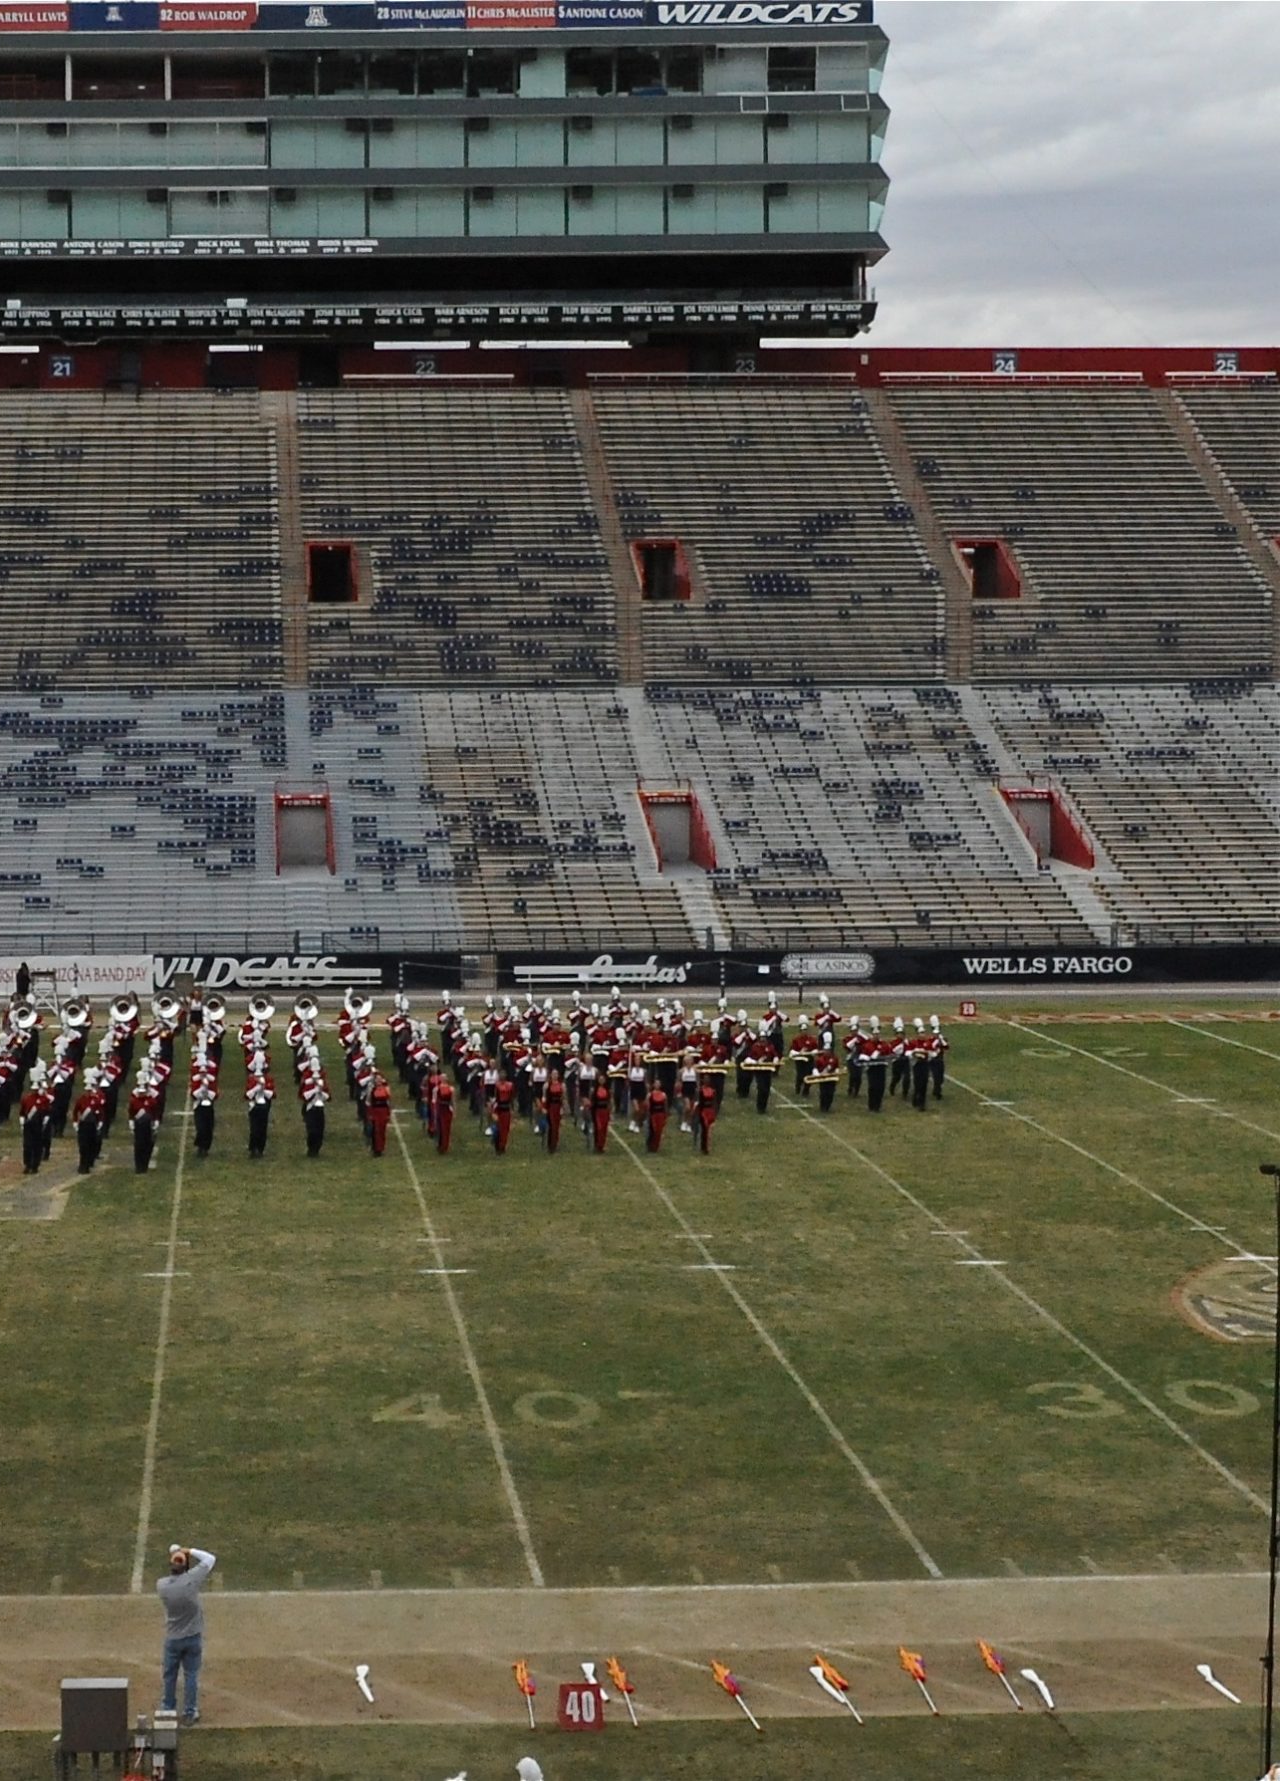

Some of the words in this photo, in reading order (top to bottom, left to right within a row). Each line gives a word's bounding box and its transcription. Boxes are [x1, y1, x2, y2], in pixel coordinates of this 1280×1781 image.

[37, 11, 67, 22] LEWIS
[160, 9, 172, 20] 92
[174, 10, 194, 20] ROB
[197, 10, 247, 20] WALDROP
[391, 9, 413, 19] STEVE
[414, 9, 466, 19] McLAUGHLIN
[467, 7, 476, 19] 11
[477, 8, 504, 19] CHRIS
[506, 8, 554, 19] McALISTER
[566, 8, 606, 18] ANTOINE
[609, 8, 643, 18] CASON
[658, 3, 862, 24] WILDCATS
[53, 362, 70, 376] 21
[415, 361, 435, 374] 22
[736, 360, 755, 373] 23
[995, 359, 1015, 373] 24
[1216, 359, 1236, 373] 25
[815, 961, 865, 971] CASINOS
[963, 958, 1047, 974] WELLS
[1052, 957, 1132, 973] FARGO
[94, 967, 124, 982] BAND
[127, 967, 147, 981] DAY
[565, 1691, 596, 1722] 40
